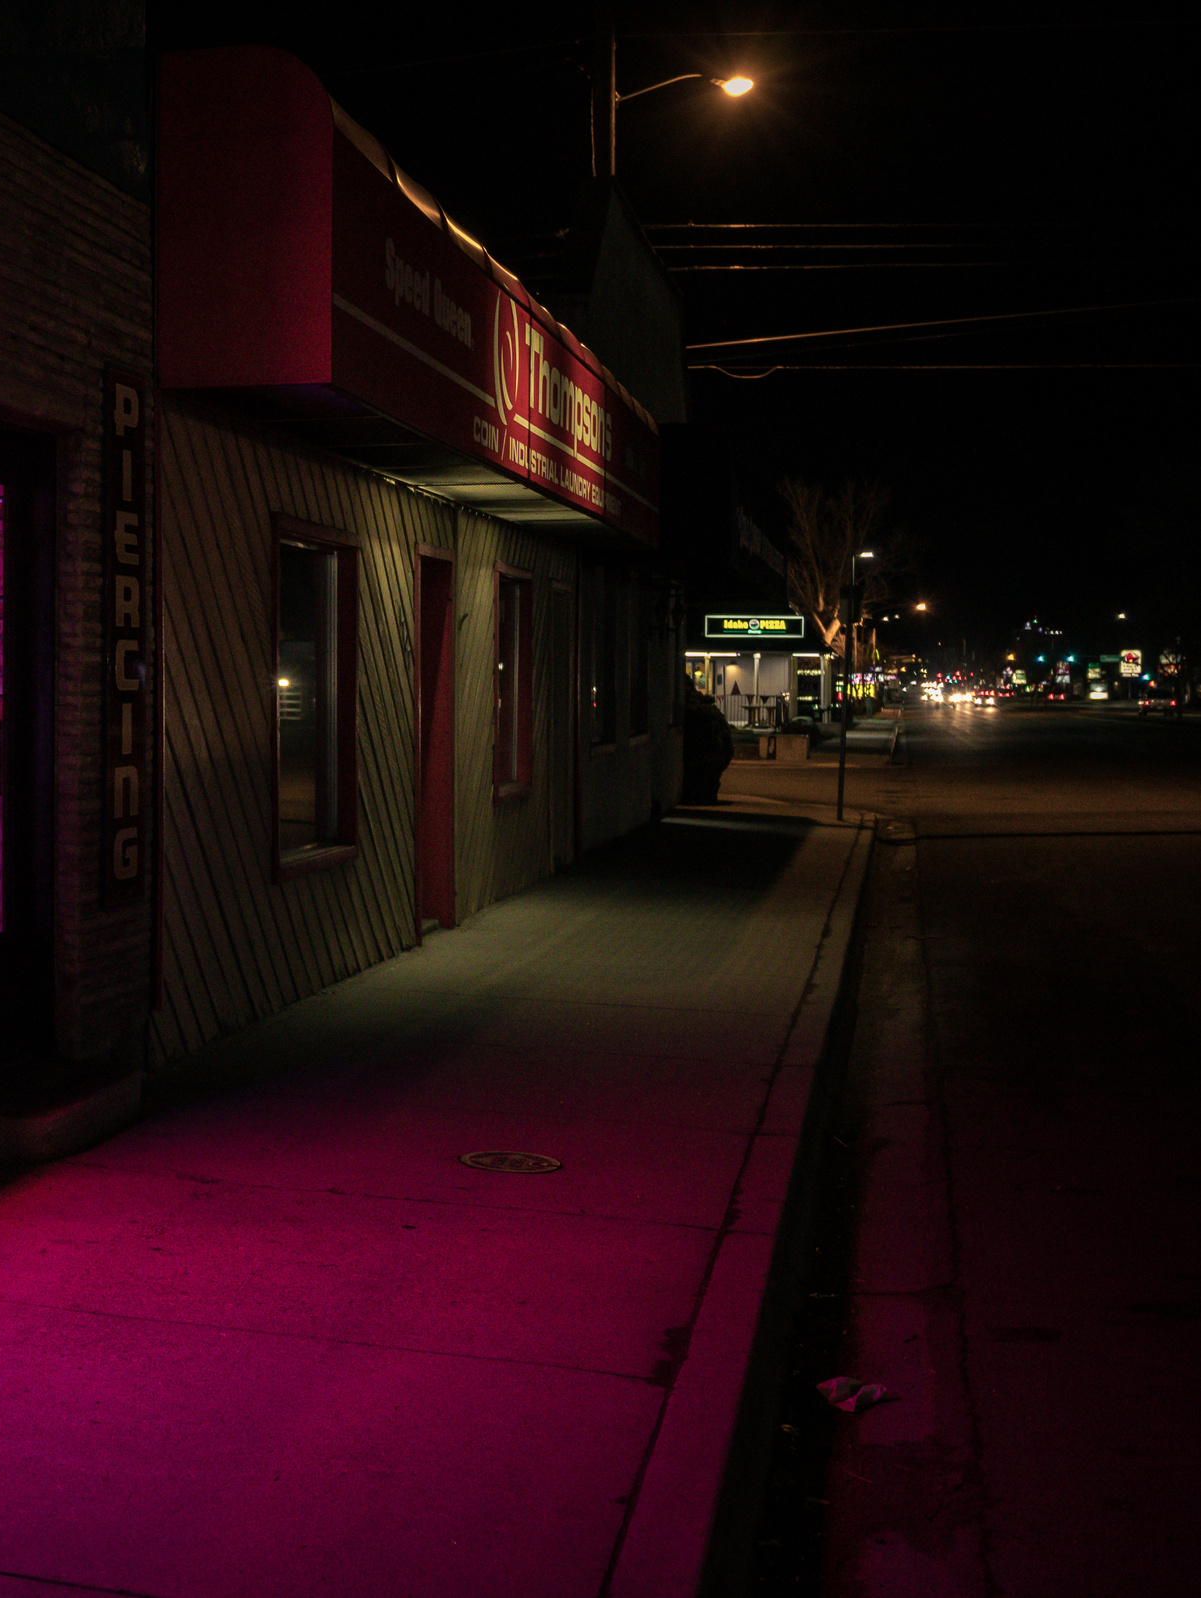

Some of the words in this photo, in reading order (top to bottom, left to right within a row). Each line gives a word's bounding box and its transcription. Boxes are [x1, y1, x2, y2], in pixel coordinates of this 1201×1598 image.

[386, 237, 429, 317] Speed
[473, 416, 499, 453] COIN
[509, 436, 558, 486] INDUSTRIAL
[560, 466, 592, 501] LAUNDRY
[723, 619, 749, 629] Idaho
[759, 620, 787, 630] PIZZA
